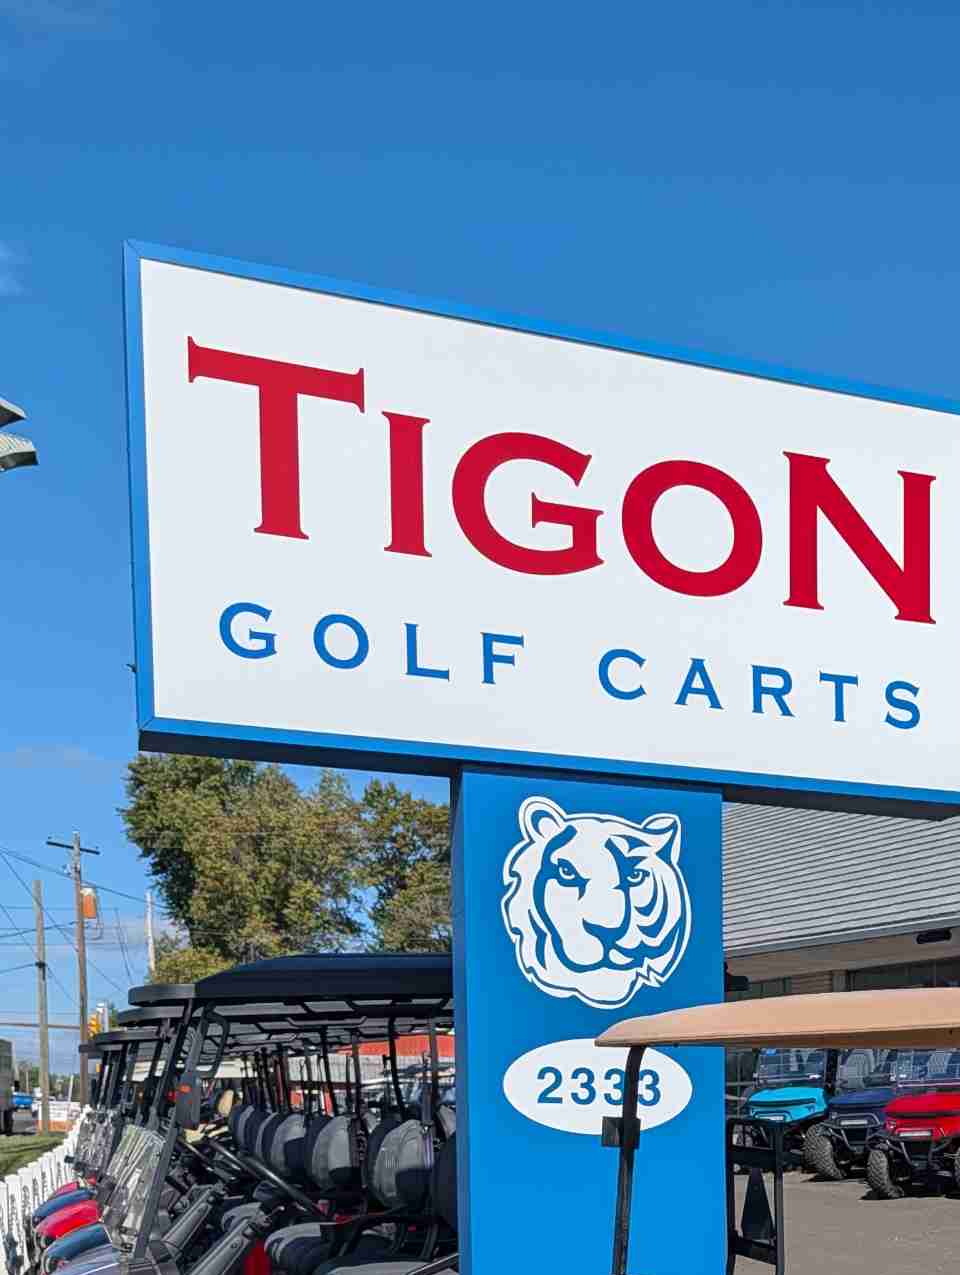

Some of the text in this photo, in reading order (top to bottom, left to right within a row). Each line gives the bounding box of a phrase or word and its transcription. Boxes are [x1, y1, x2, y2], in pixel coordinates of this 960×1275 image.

[188, 336, 936, 624] TIGON
[218, 602, 921, 730] GOLF CARTS
[537, 1066, 661, 1107] 2333
